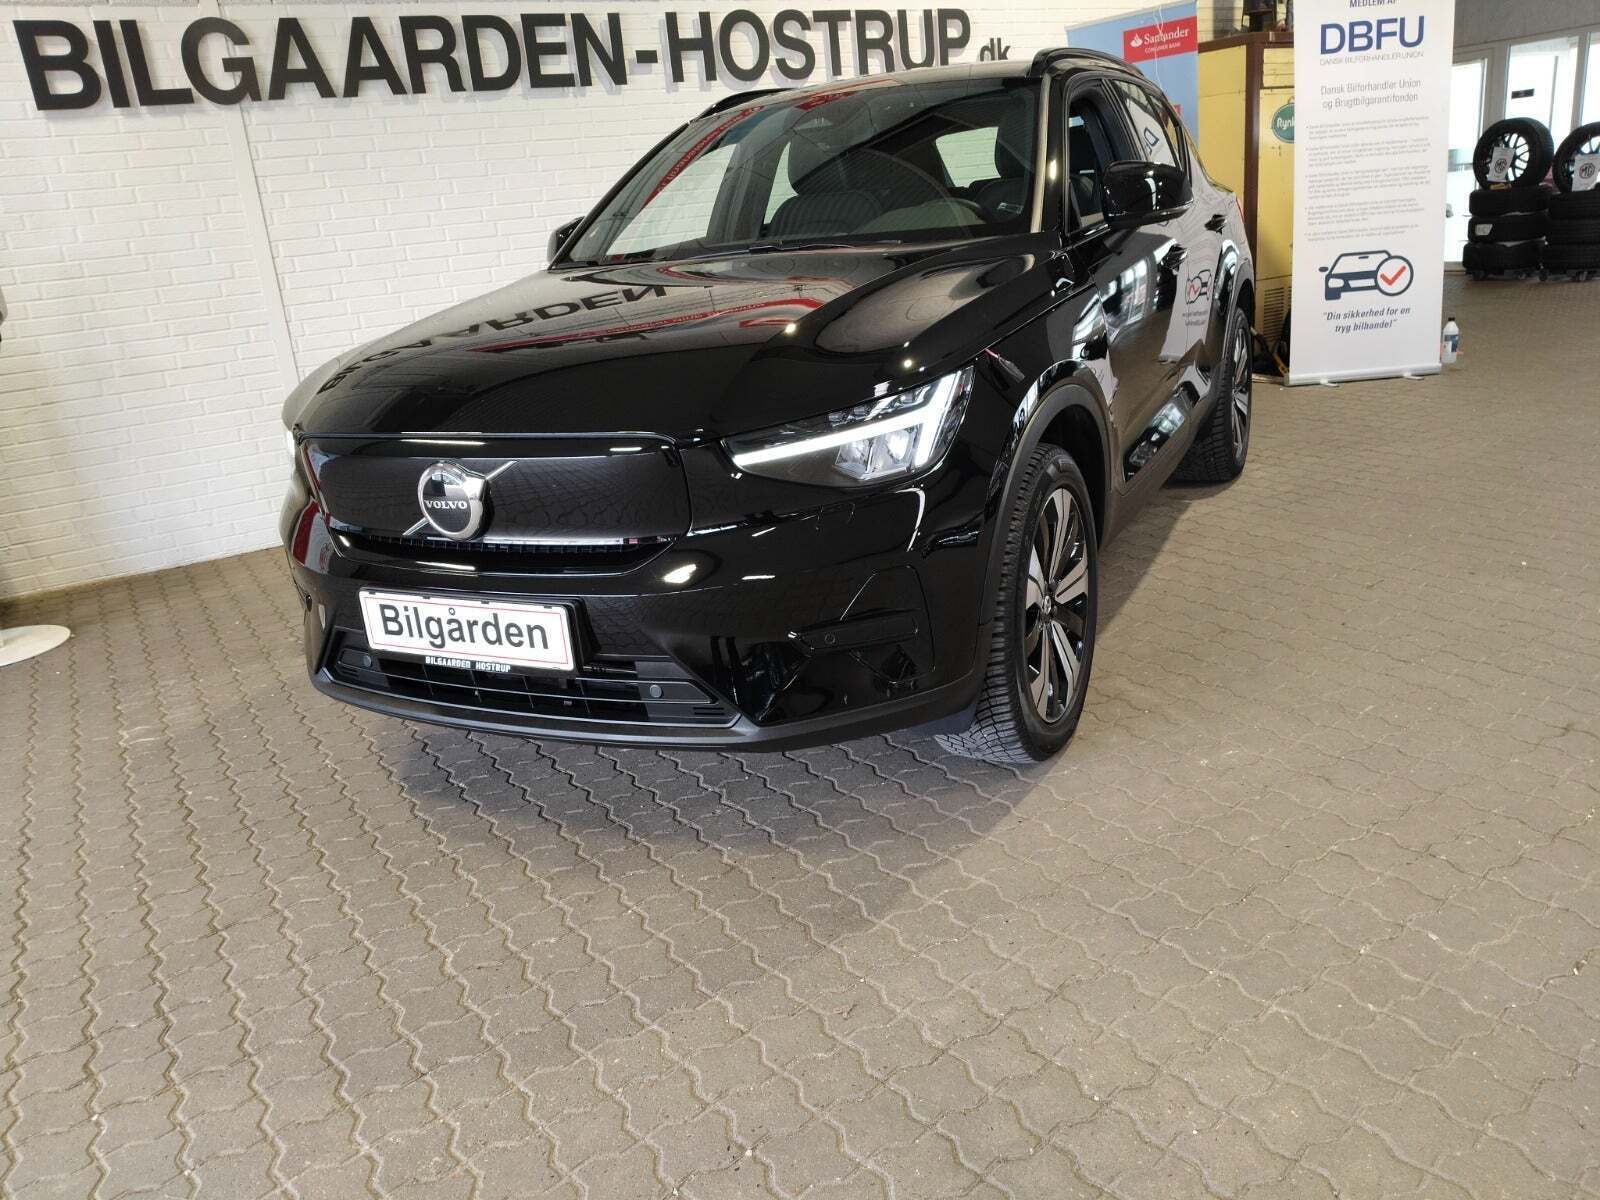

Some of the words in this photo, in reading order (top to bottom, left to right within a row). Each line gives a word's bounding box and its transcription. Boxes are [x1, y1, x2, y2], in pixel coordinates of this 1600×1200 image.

[1143, 26, 1190, 45] Santander
[1320, 15, 1425, 55] DBFU
[1320, 84, 1345, 96] Dansk
[1347, 81, 1397, 93] Bilforhandler
[1399, 78, 1421, 89] Union
[1322, 100, 1333, 111] og
[1335, 93, 1418, 109] Brugtbilgarantifonden
[1343, 307, 1385, 320] sikkerhed
[1386, 306, 1398, 316] for
[1400, 307, 1411, 315] en
[1335, 323, 1352, 334] tryg
[423, 499, 468, 510] VOLVO
[379, 603, 549, 650] Bilgården
[425, 655, 471, 669] BILGAARDEN
[475, 660, 511, 673] HOSTRUP
